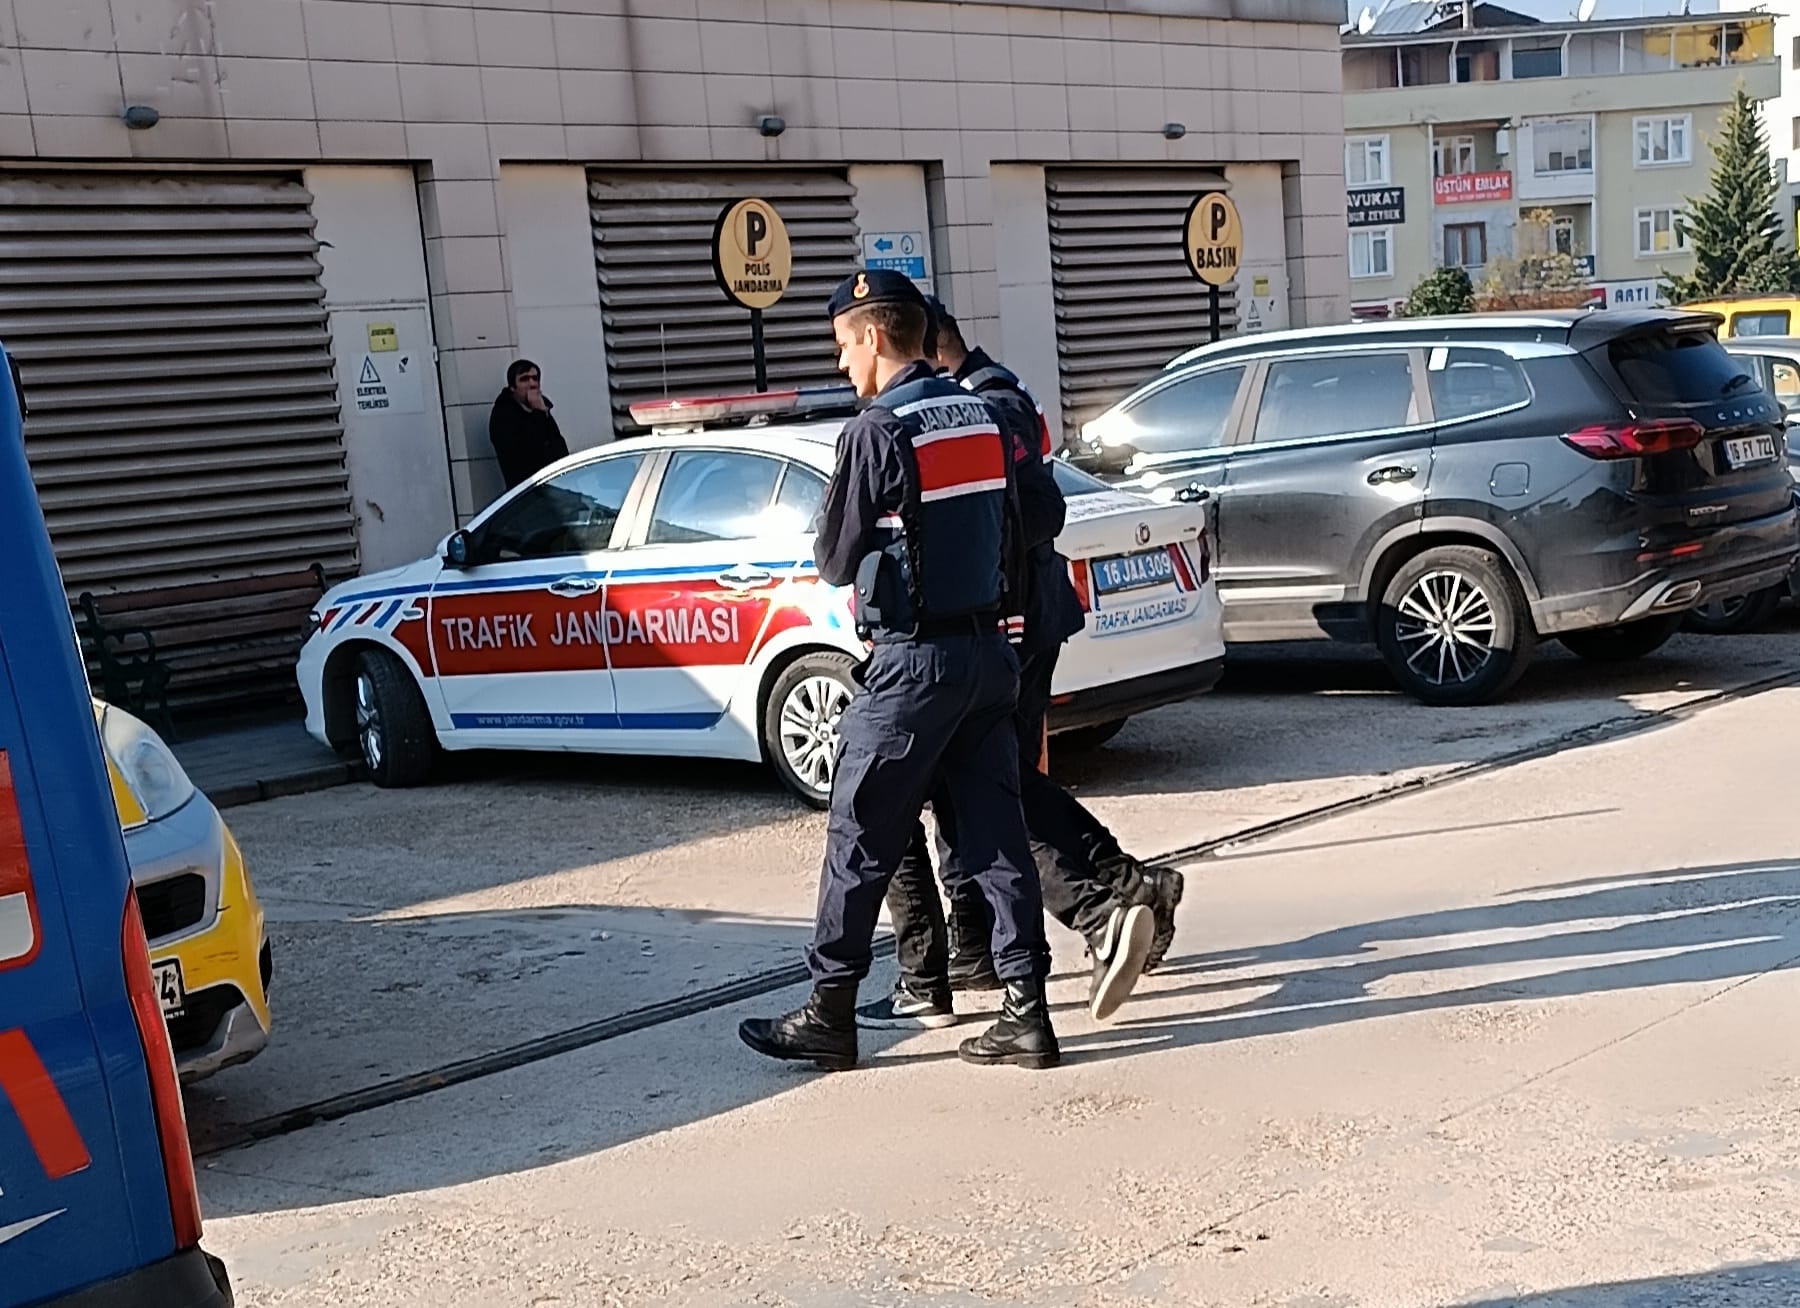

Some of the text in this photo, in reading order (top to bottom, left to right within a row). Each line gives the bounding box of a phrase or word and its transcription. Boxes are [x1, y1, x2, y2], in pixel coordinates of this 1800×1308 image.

[1475, 176, 1509, 191] EMLAK
[1347, 191, 1400, 208] AVUKAT
[746, 210, 767, 256] P
[1211, 202, 1226, 241] P
[1196, 246, 1237, 269] BASIN
[733, 279, 783, 293] JANDARMA
[918, 402, 992, 433] JANDARMA
[1742, 440, 1754, 459] FY
[1103, 552, 1171, 585] 16 JAA 309
[1131, 597, 1188, 625] JANDARMASI
[550, 606, 739, 646] JANDARMASI
